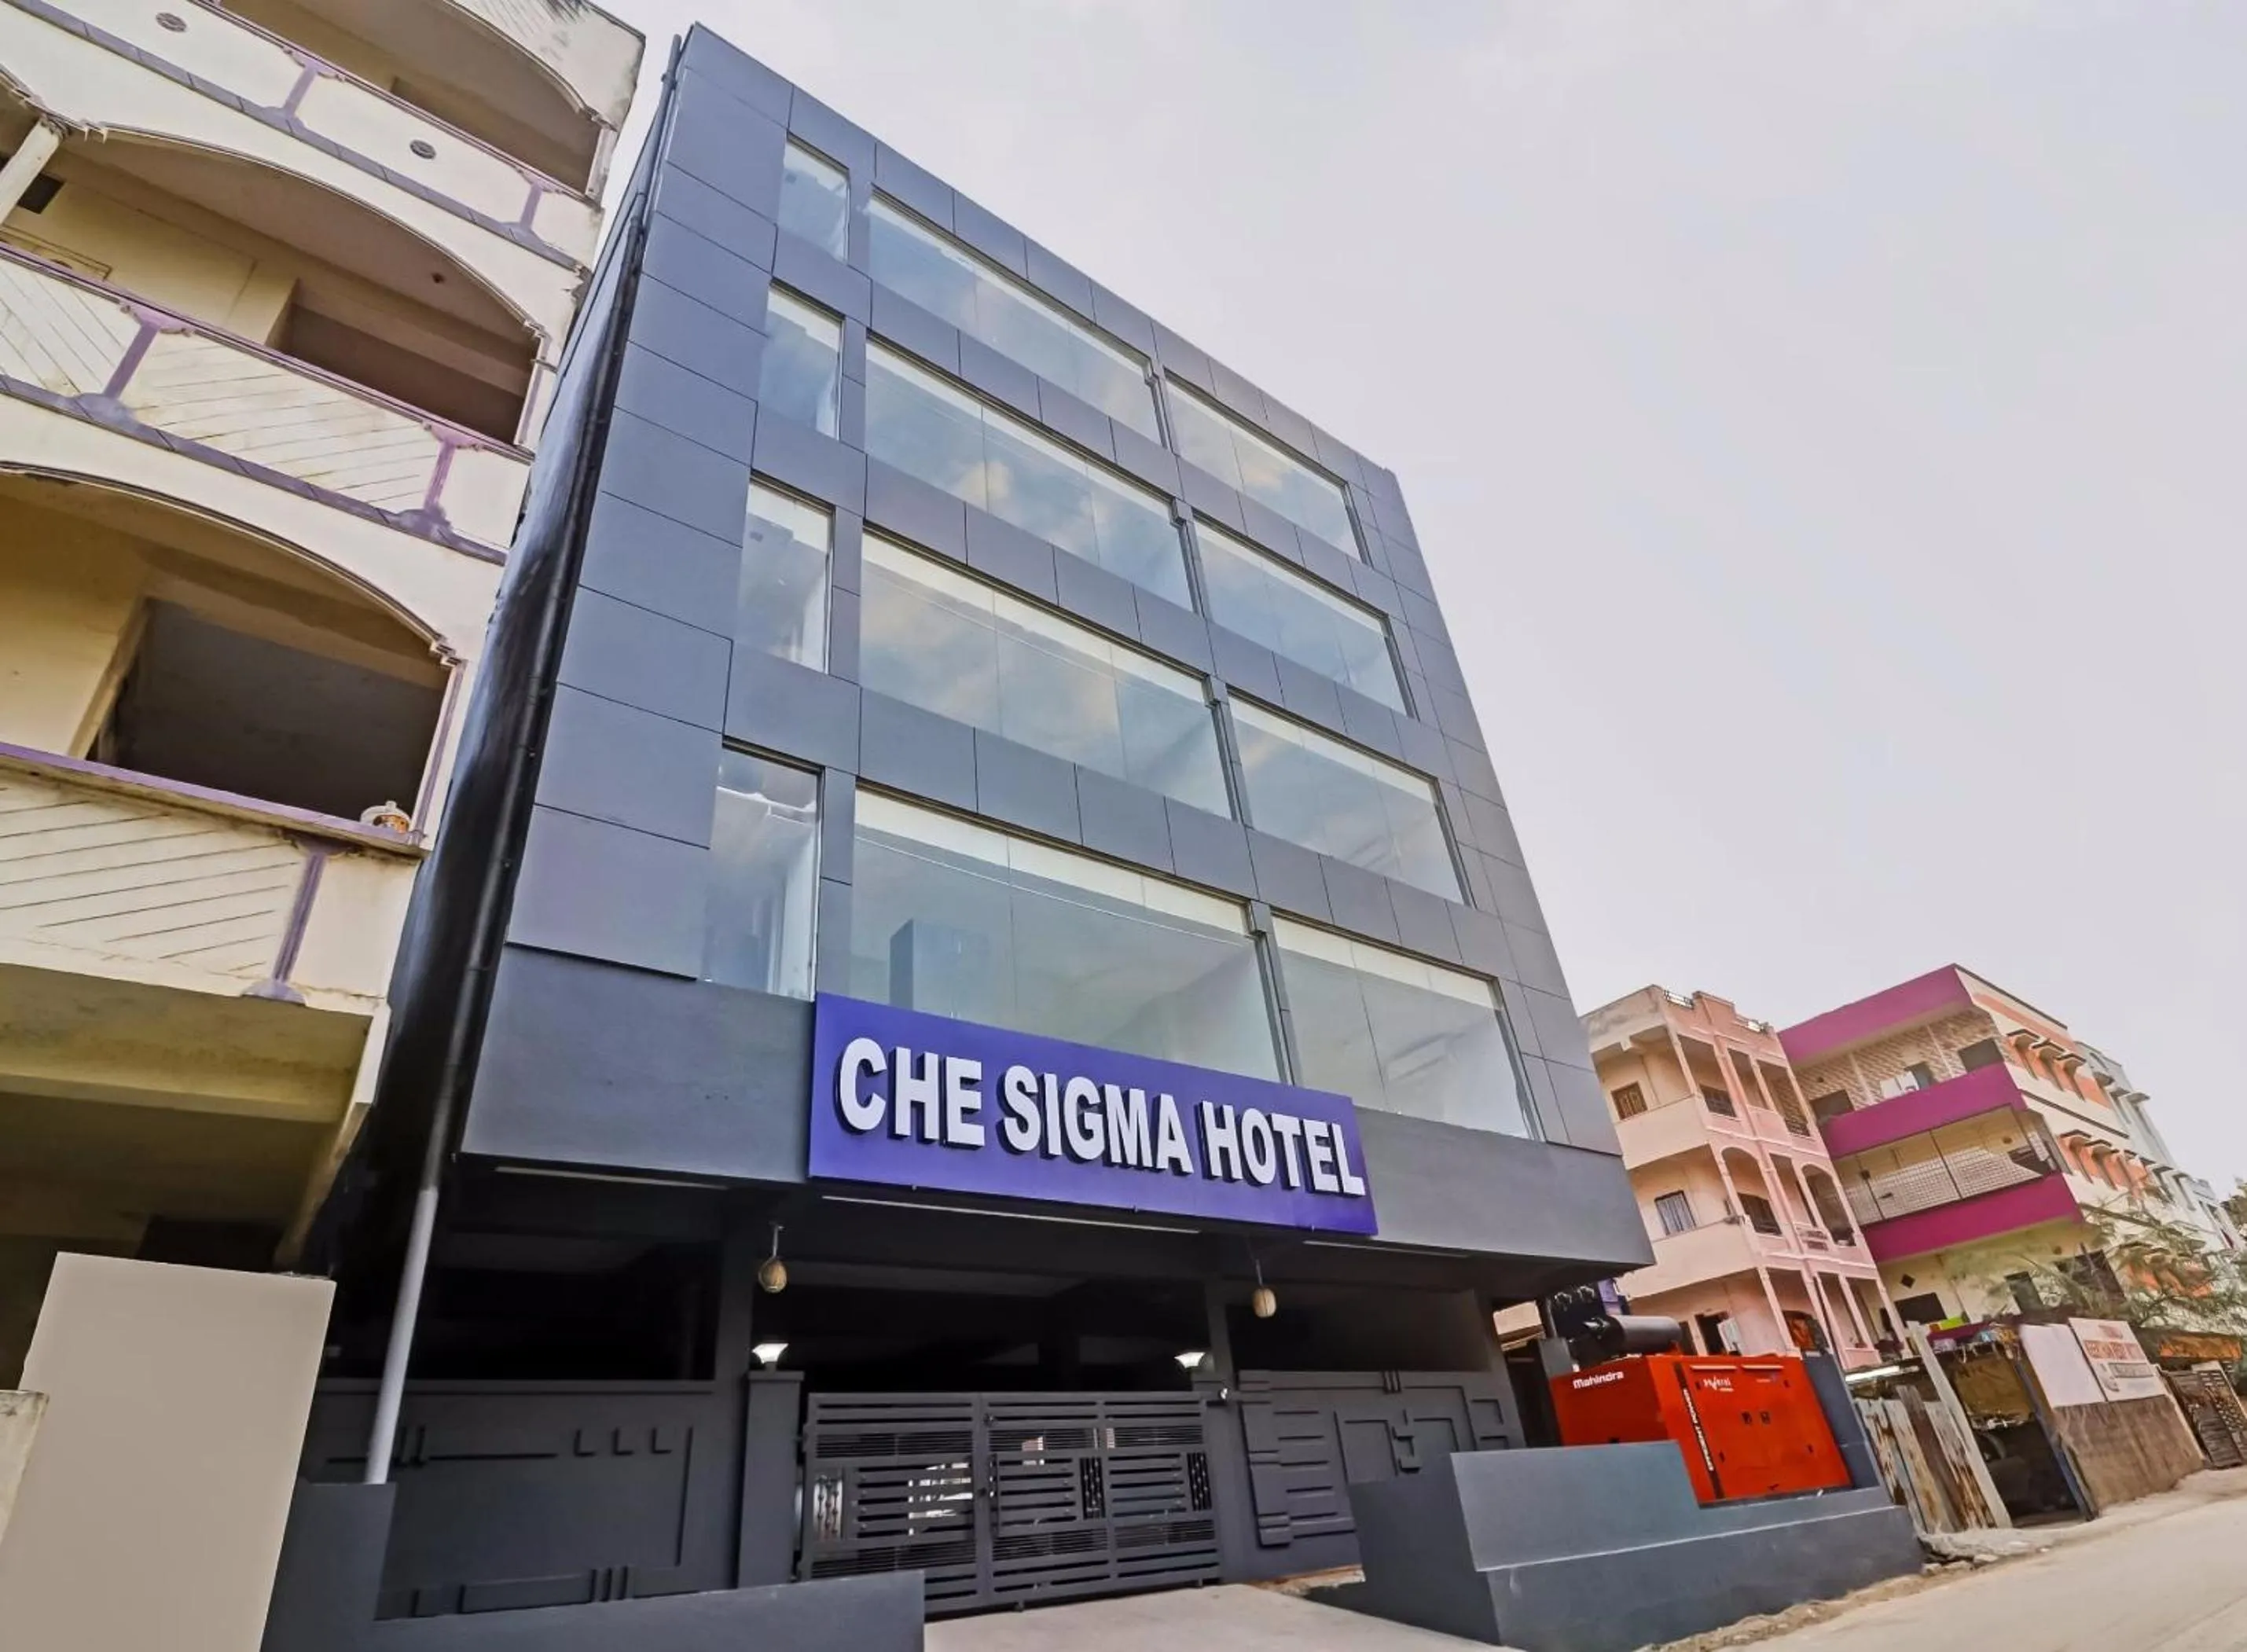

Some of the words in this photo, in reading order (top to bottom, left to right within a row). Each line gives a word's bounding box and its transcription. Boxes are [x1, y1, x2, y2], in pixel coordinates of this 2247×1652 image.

[839, 1037, 986, 1147] CHE
[1003, 1064, 1195, 1174] SIGMA
[1201, 1099, 1366, 1196] HOTEL
